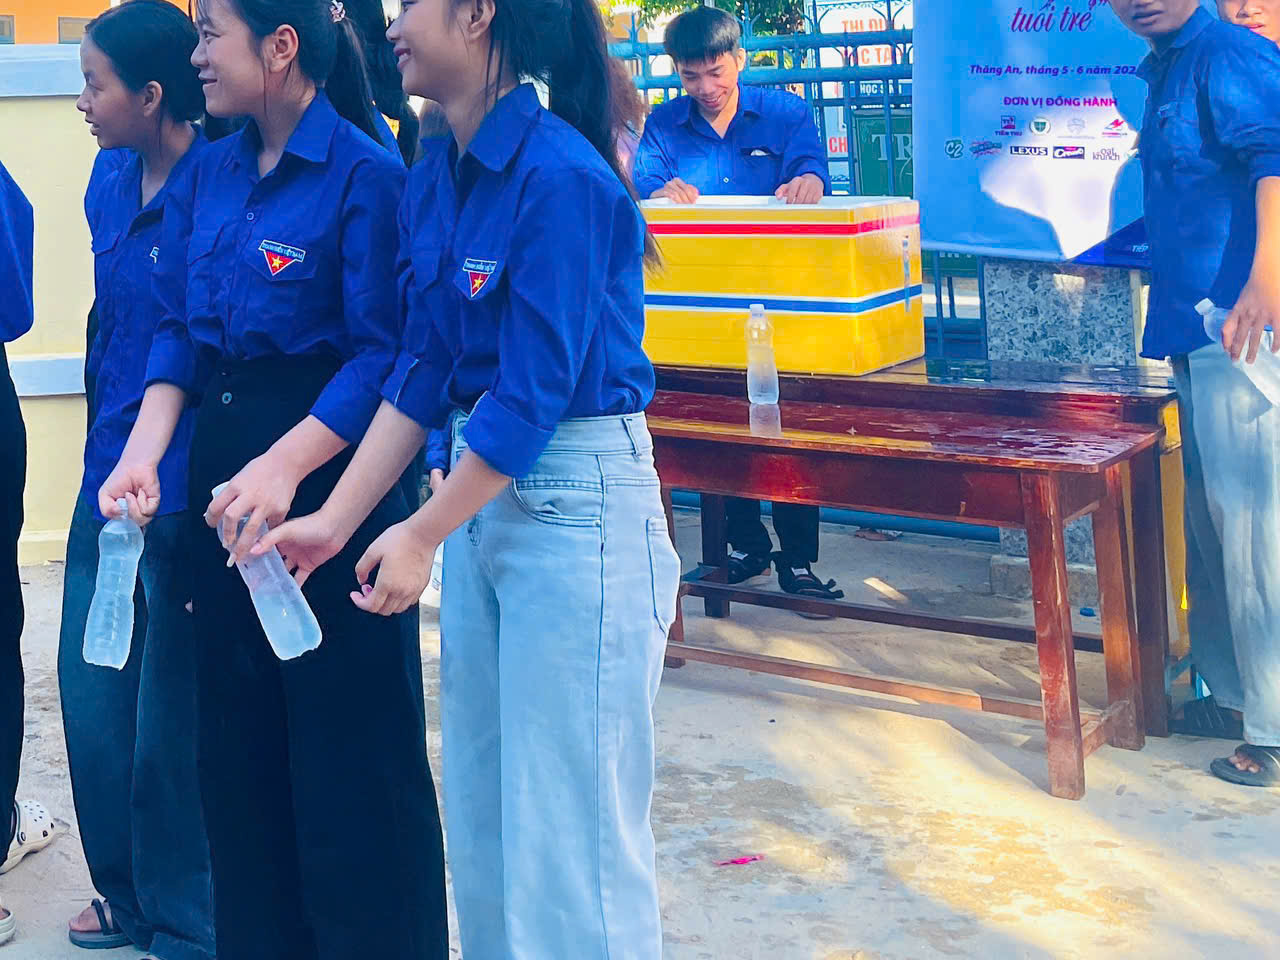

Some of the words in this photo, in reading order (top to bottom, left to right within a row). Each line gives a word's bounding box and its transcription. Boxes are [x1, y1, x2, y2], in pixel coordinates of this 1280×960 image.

[1004, 65, 1022, 75] An,
[1026, 65, 1059, 76] tháng
[1062, 65, 1068, 74] 5
[1076, 65, 1084, 74] 6
[1086, 66, 1111, 75] năm
[1113, 65, 1136, 75] 202
[860, 83, 878, 96] HỌC
[1004, 96, 1029, 106] ĐƠN
[1032, 97, 1042, 108] VỊ
[1046, 95, 1081, 107] ĐỒNG
[1083, 96, 1118, 107] HÀNH
[946, 142, 963, 158] C2
[1011, 146, 1048, 155] LEXUS
